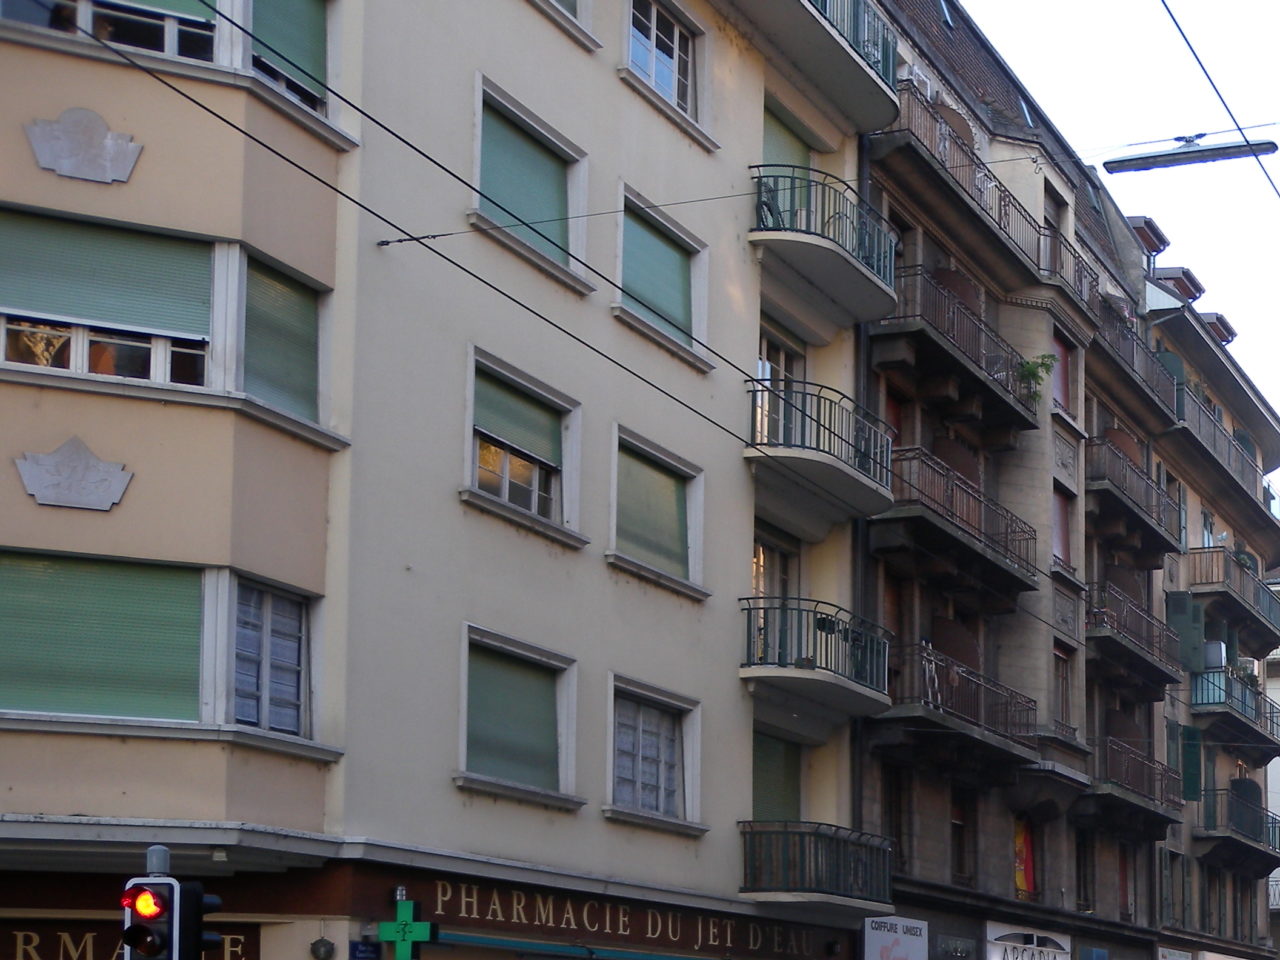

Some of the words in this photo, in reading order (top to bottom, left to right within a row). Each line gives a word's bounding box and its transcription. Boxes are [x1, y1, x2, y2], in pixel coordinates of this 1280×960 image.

[434, 880, 631, 936] PHARMACIE
[645, 909, 682, 941] DU
[694, 915, 736, 950] JET
[749, 922, 815, 957] D'EAU
[870, 920, 898, 934] COIFFURE
[902, 924, 923, 937] UNISEX
